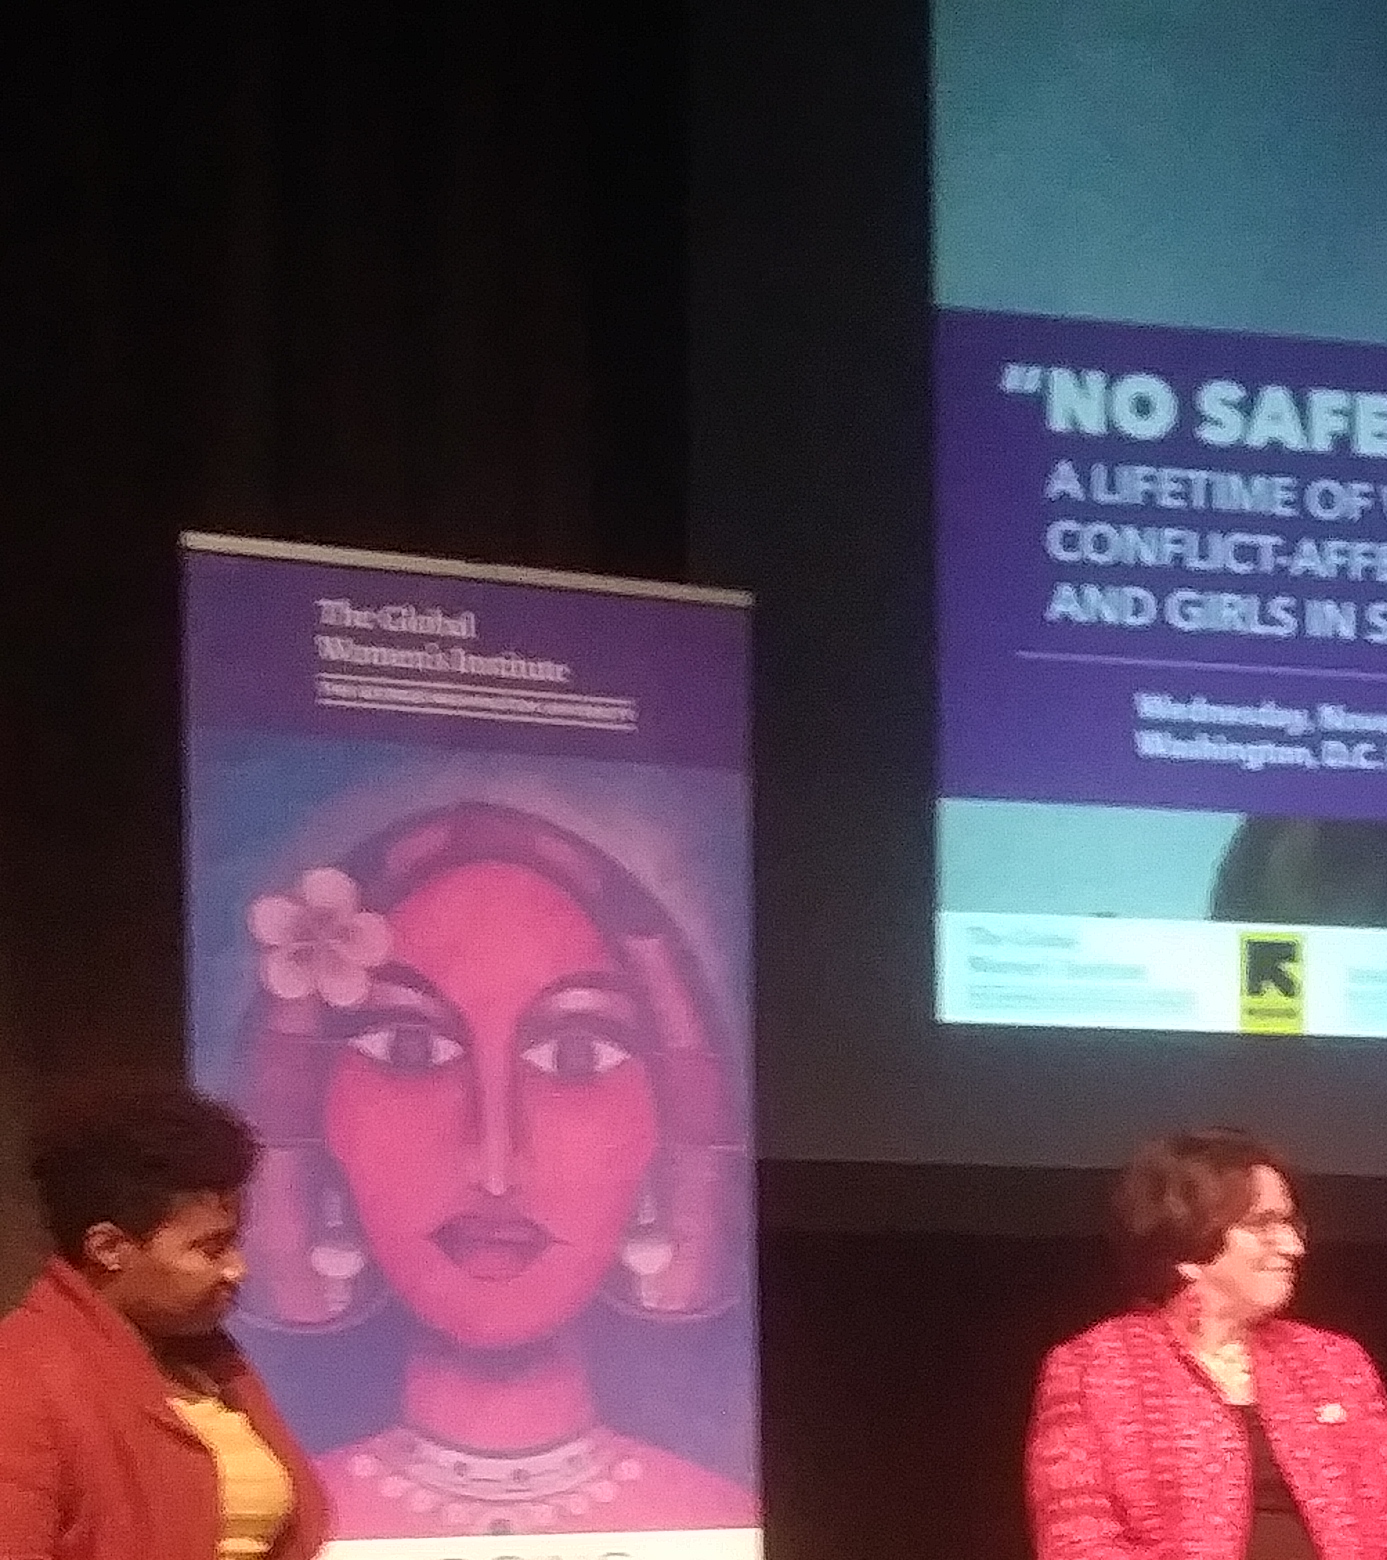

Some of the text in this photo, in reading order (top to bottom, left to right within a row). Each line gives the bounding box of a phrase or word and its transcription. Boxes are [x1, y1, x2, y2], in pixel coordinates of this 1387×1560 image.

[1045, 459, 1084, 500] A
[1091, 462, 1298, 517] LIFETIME
[1305, 479, 1377, 521] OF
[315, 599, 477, 639] The Global
[1045, 583, 1157, 627] AND
[1165, 589, 1298, 638] GIRLS
[1304, 599, 1358, 640] IN
[451, 646, 573, 684] Institute
